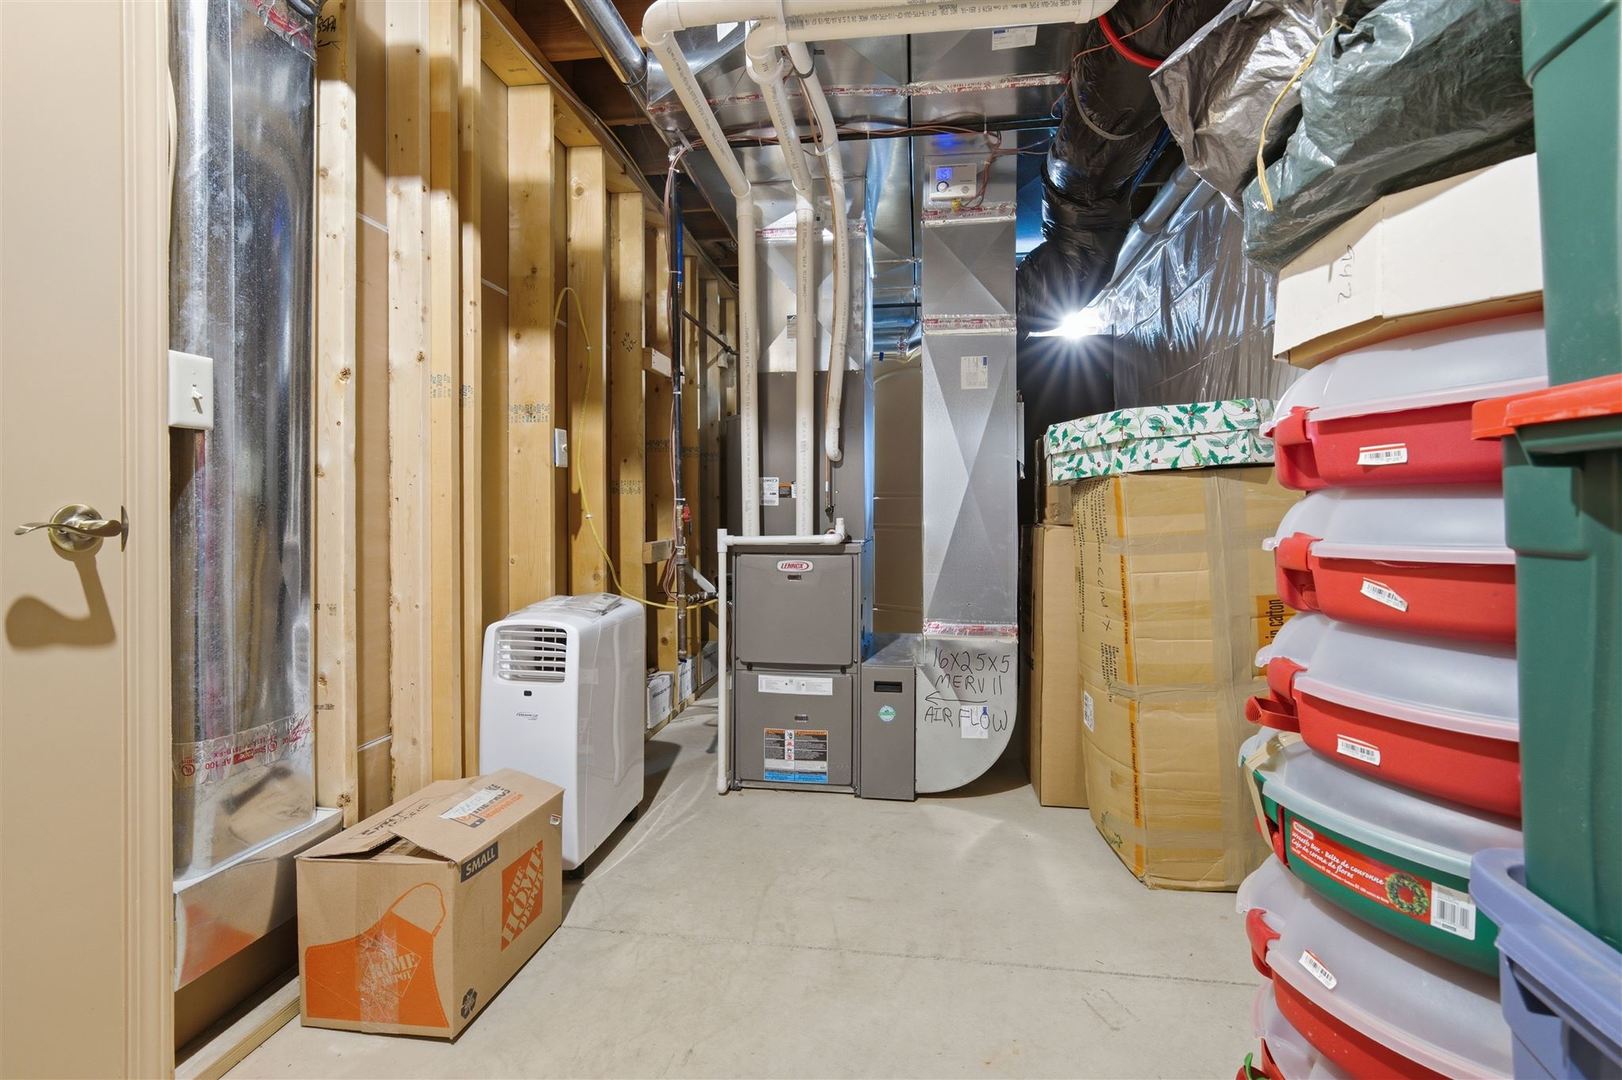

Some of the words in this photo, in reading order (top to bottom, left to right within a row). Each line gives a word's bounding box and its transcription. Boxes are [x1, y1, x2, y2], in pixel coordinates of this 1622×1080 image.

[779, 562, 803, 570] LENNOX
[1265, 599, 1285, 627] carton
[934, 673, 985, 694] MERV
[992, 675, 1003, 695] 11
[924, 706, 953, 727] AIR
[958, 708, 1008, 732] FLOW
[465, 847, 497, 877] SMALL
[502, 848, 543, 940] HOME
[506, 866, 526, 903] THE
